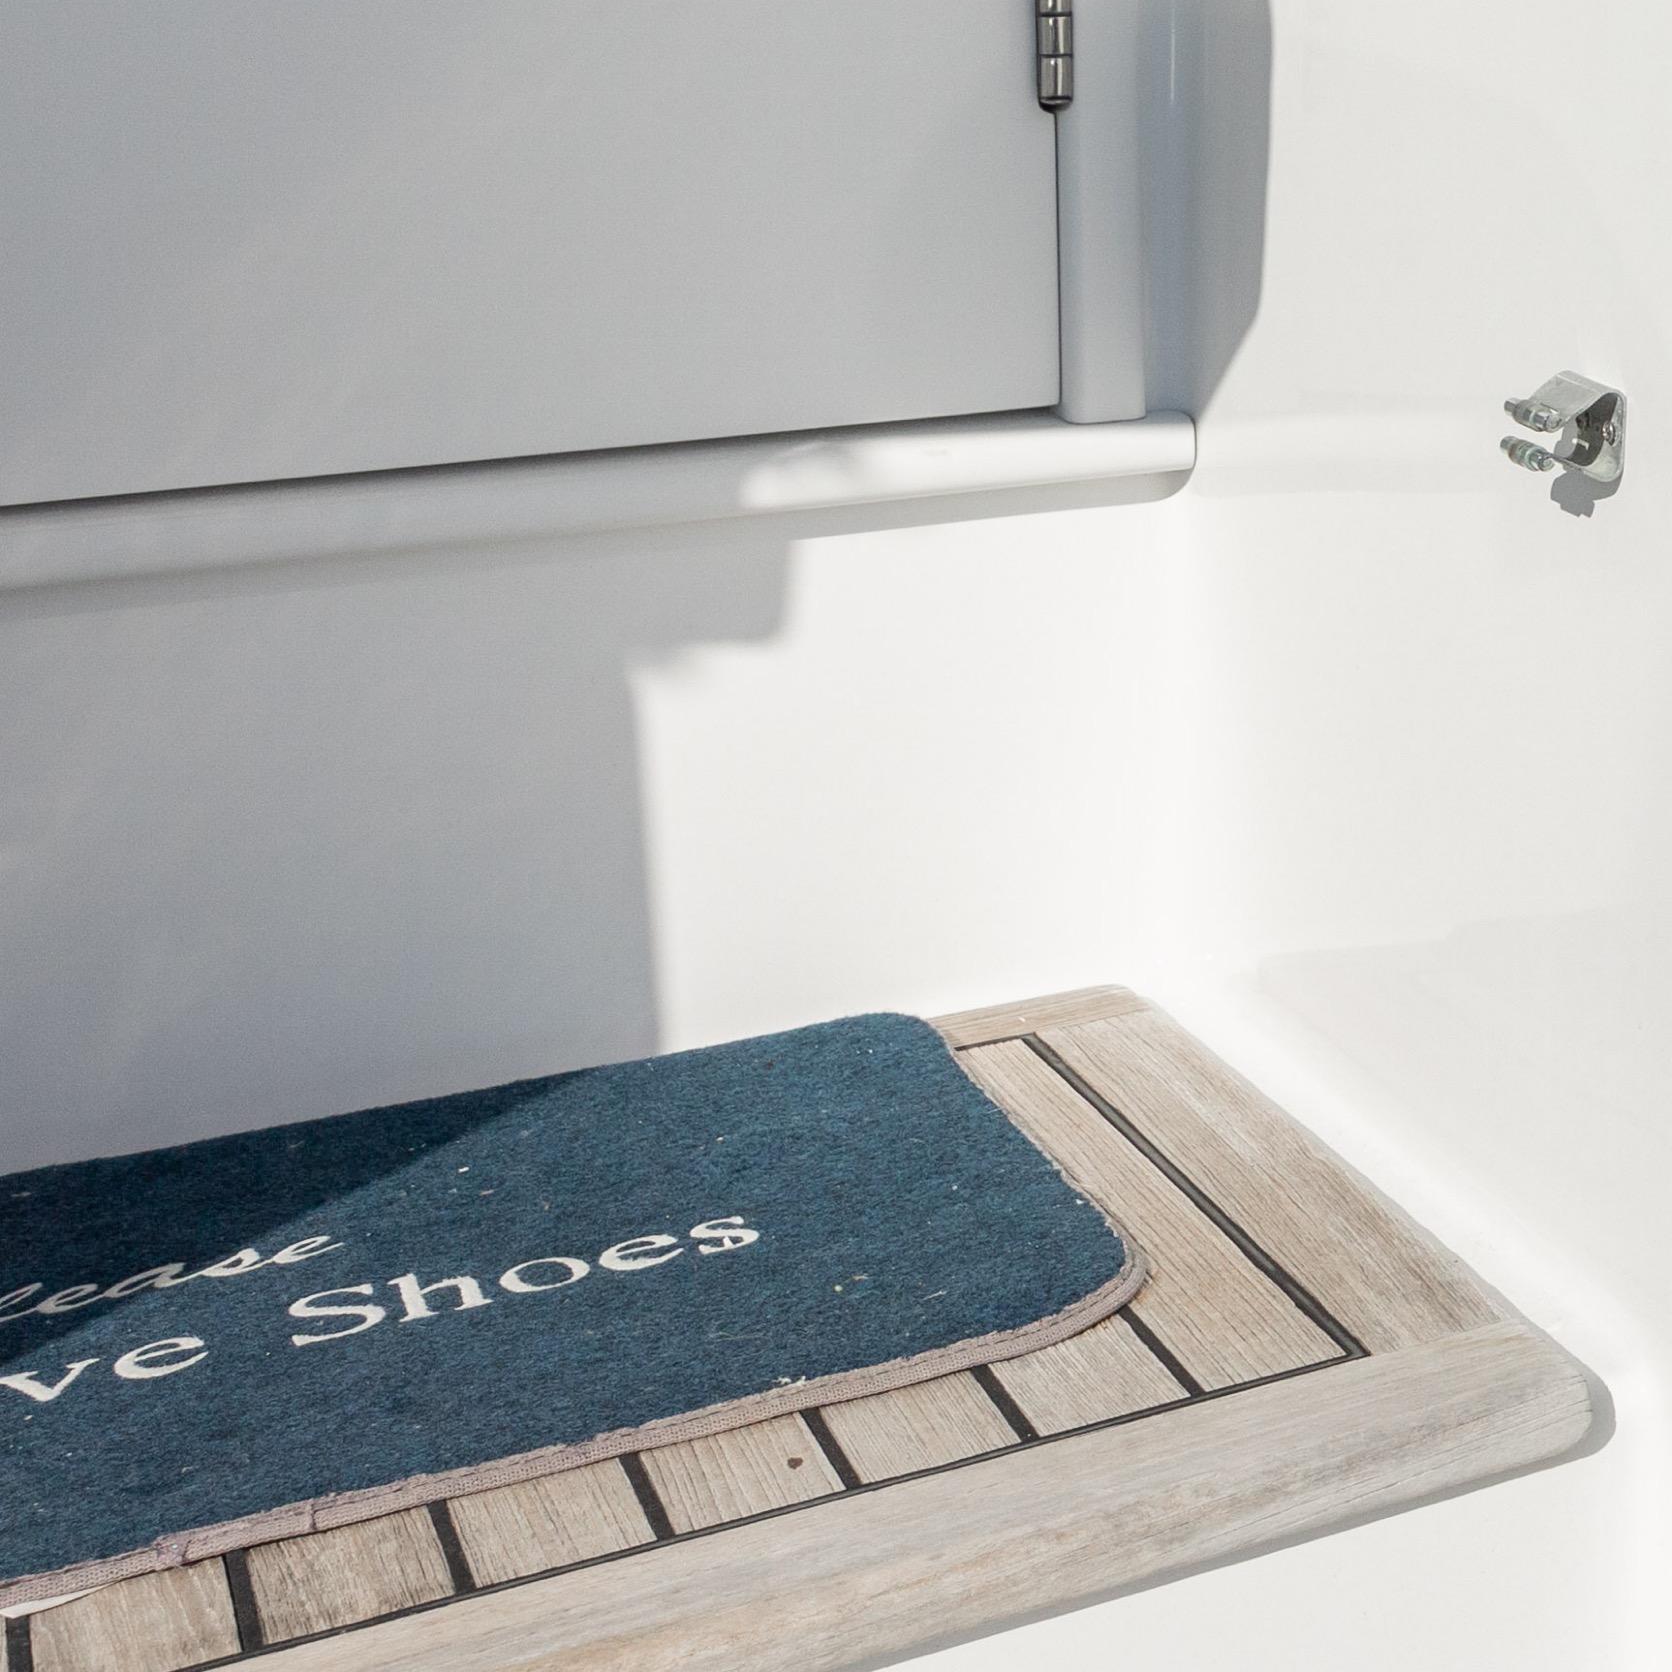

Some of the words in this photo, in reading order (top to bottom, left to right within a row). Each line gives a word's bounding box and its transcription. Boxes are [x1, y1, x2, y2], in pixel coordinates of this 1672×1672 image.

[0, 1233, 346, 1323] lease
[0, 1336, 206, 1402] ve
[288, 1214, 760, 1346] Shoes
